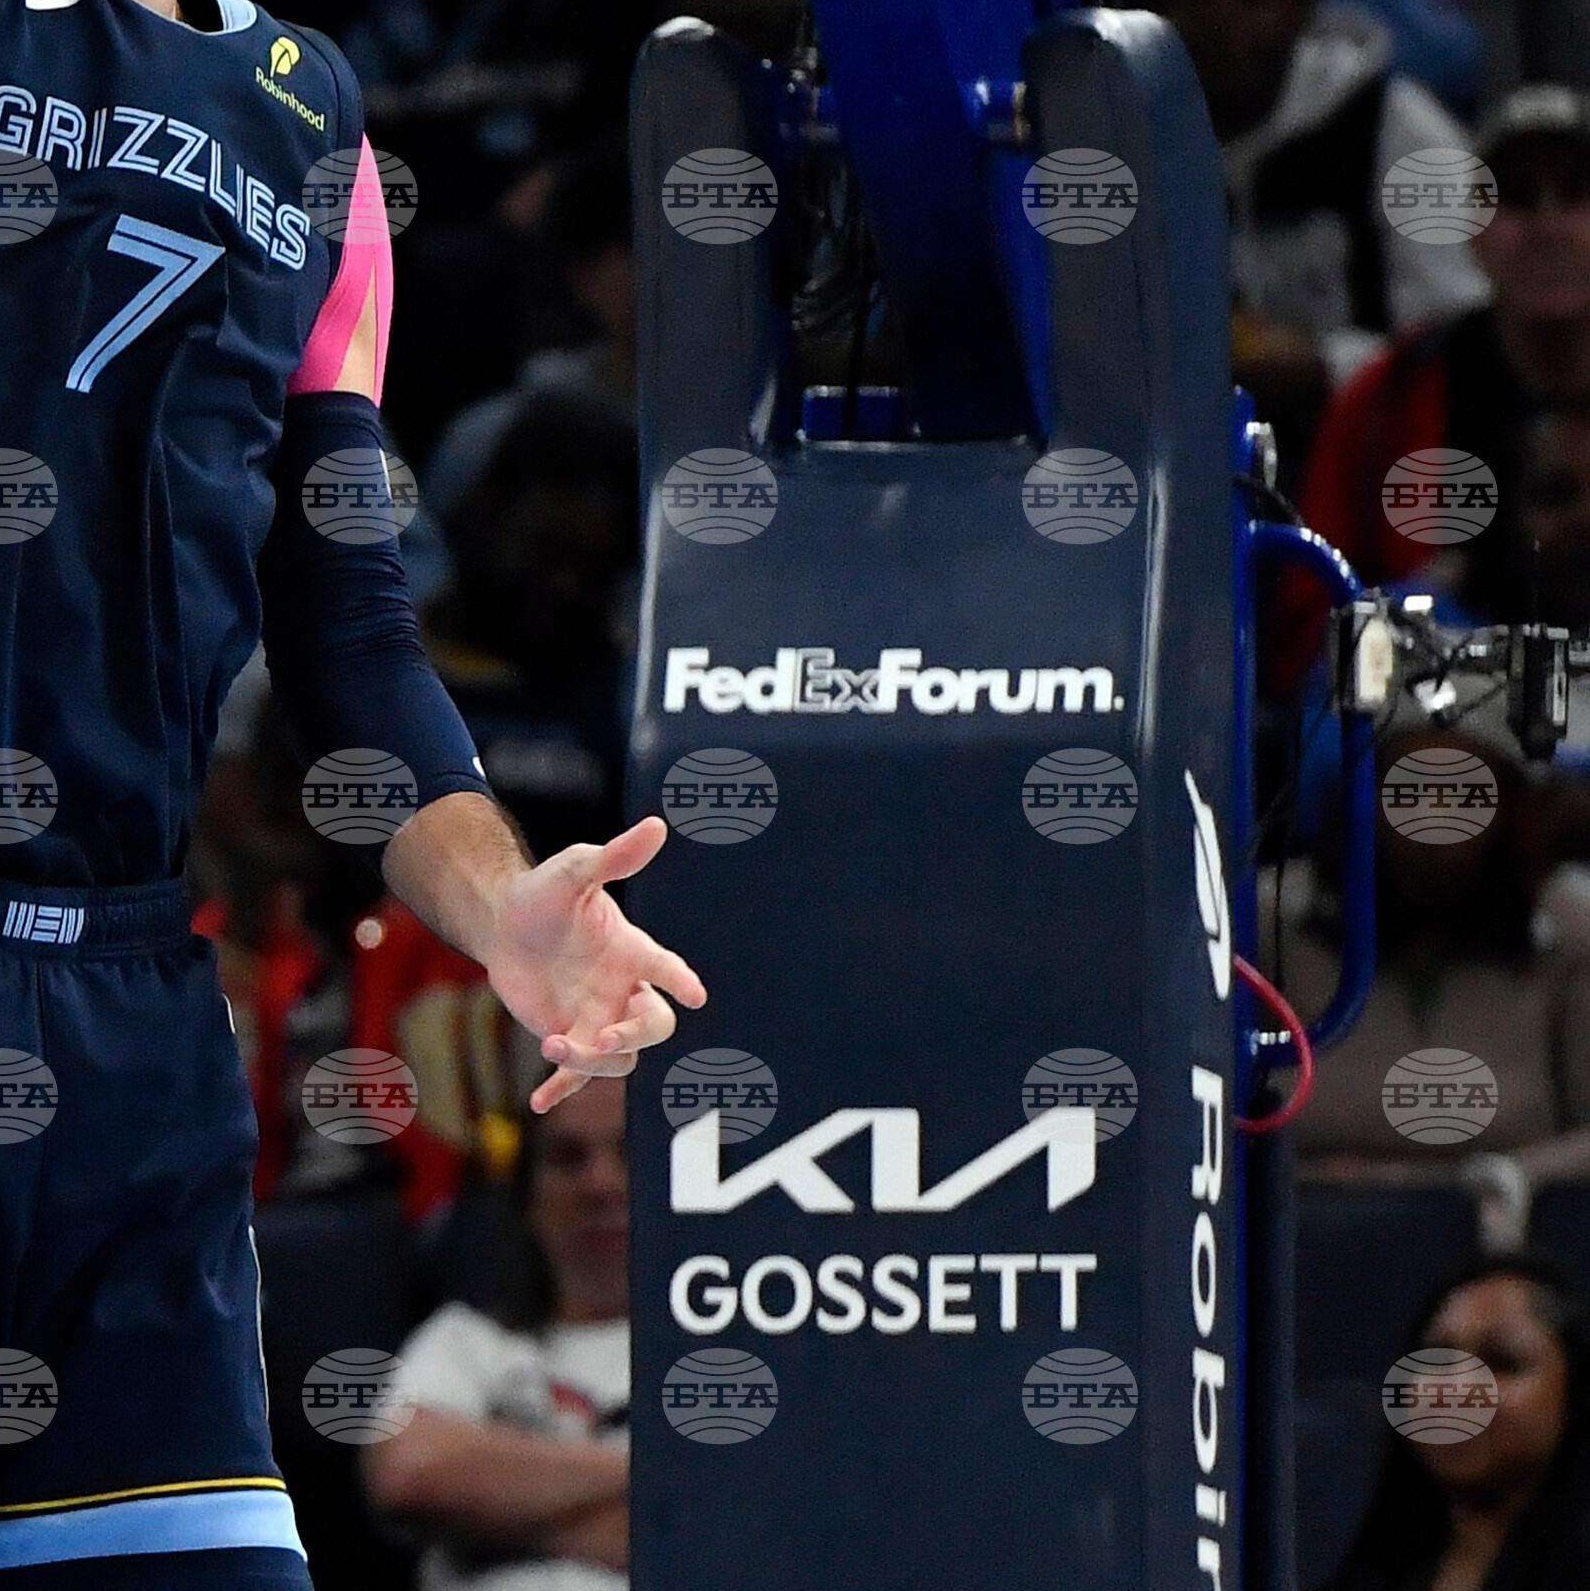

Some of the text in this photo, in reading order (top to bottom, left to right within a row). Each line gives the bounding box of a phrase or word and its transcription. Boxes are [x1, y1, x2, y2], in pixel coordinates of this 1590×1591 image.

[255, 66, 325, 132] Robinhood
[65, 213, 226, 394] 7
[669, 1106, 1097, 1214] KIA
[668, 1253, 1098, 1336] GOSSETT
